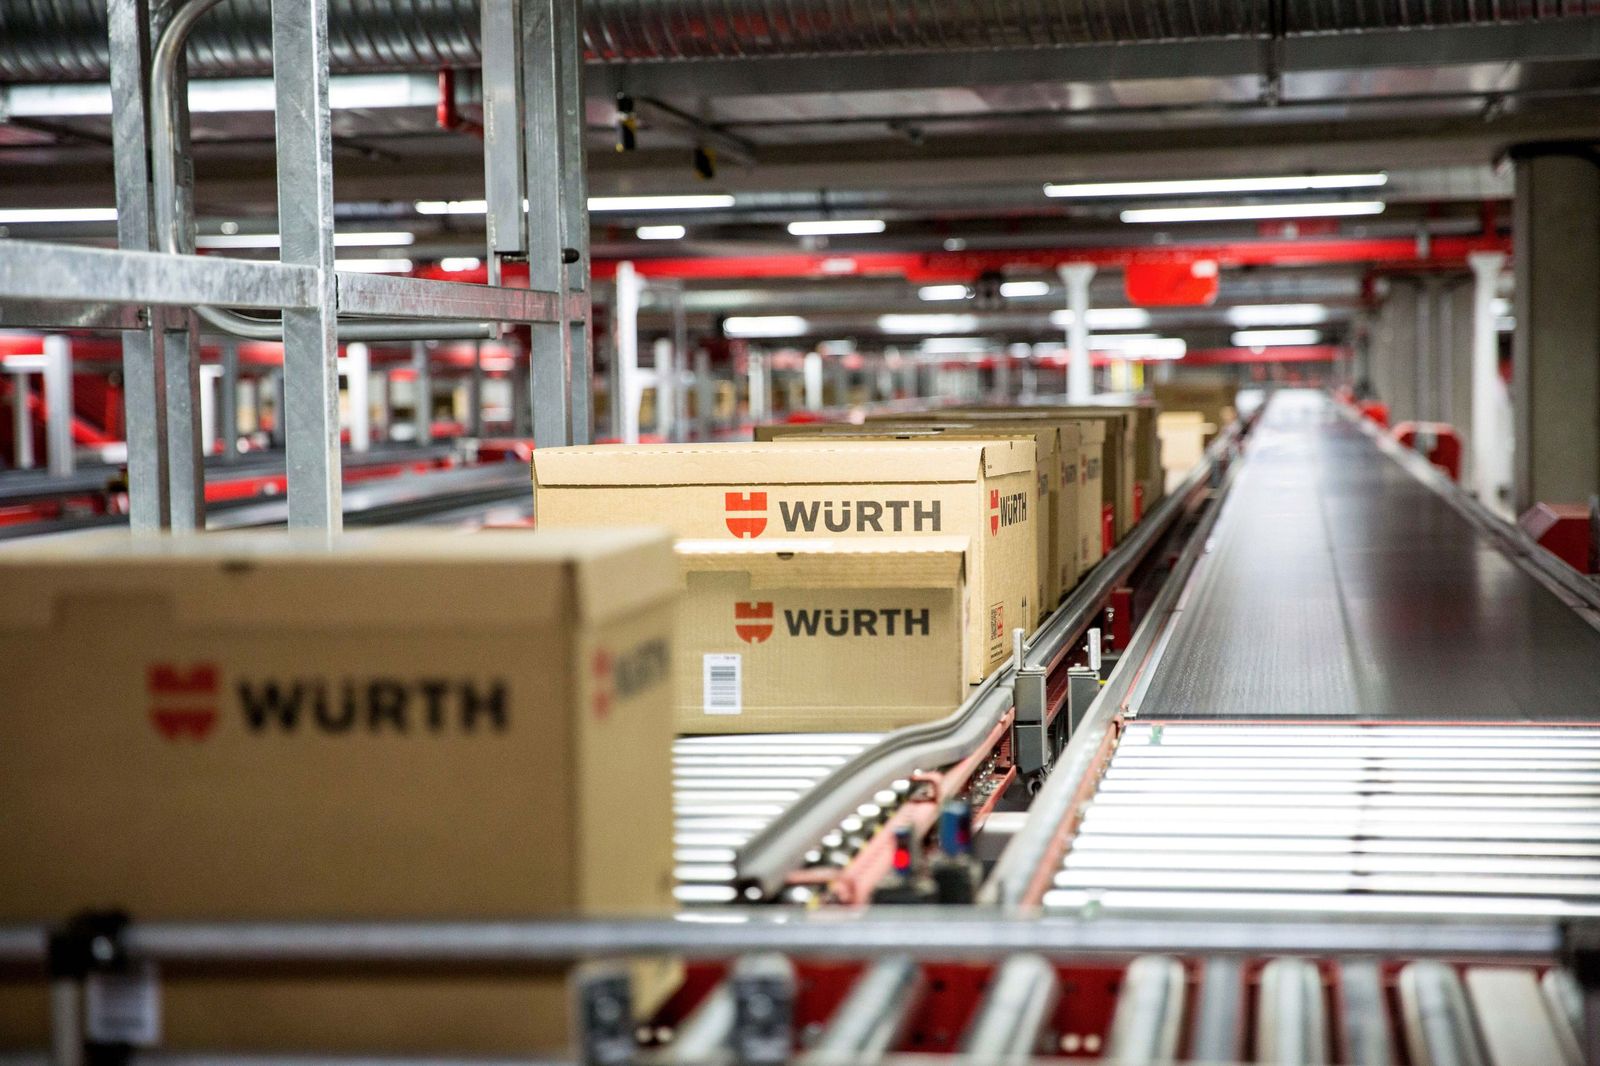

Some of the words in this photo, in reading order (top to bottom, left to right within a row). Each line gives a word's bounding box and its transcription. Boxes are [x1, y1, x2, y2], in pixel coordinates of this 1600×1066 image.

[779, 500, 941, 533] WÜRTH
[1000, 491, 1027, 527] WÜRTH
[784, 608, 931, 637] WÜRTH
